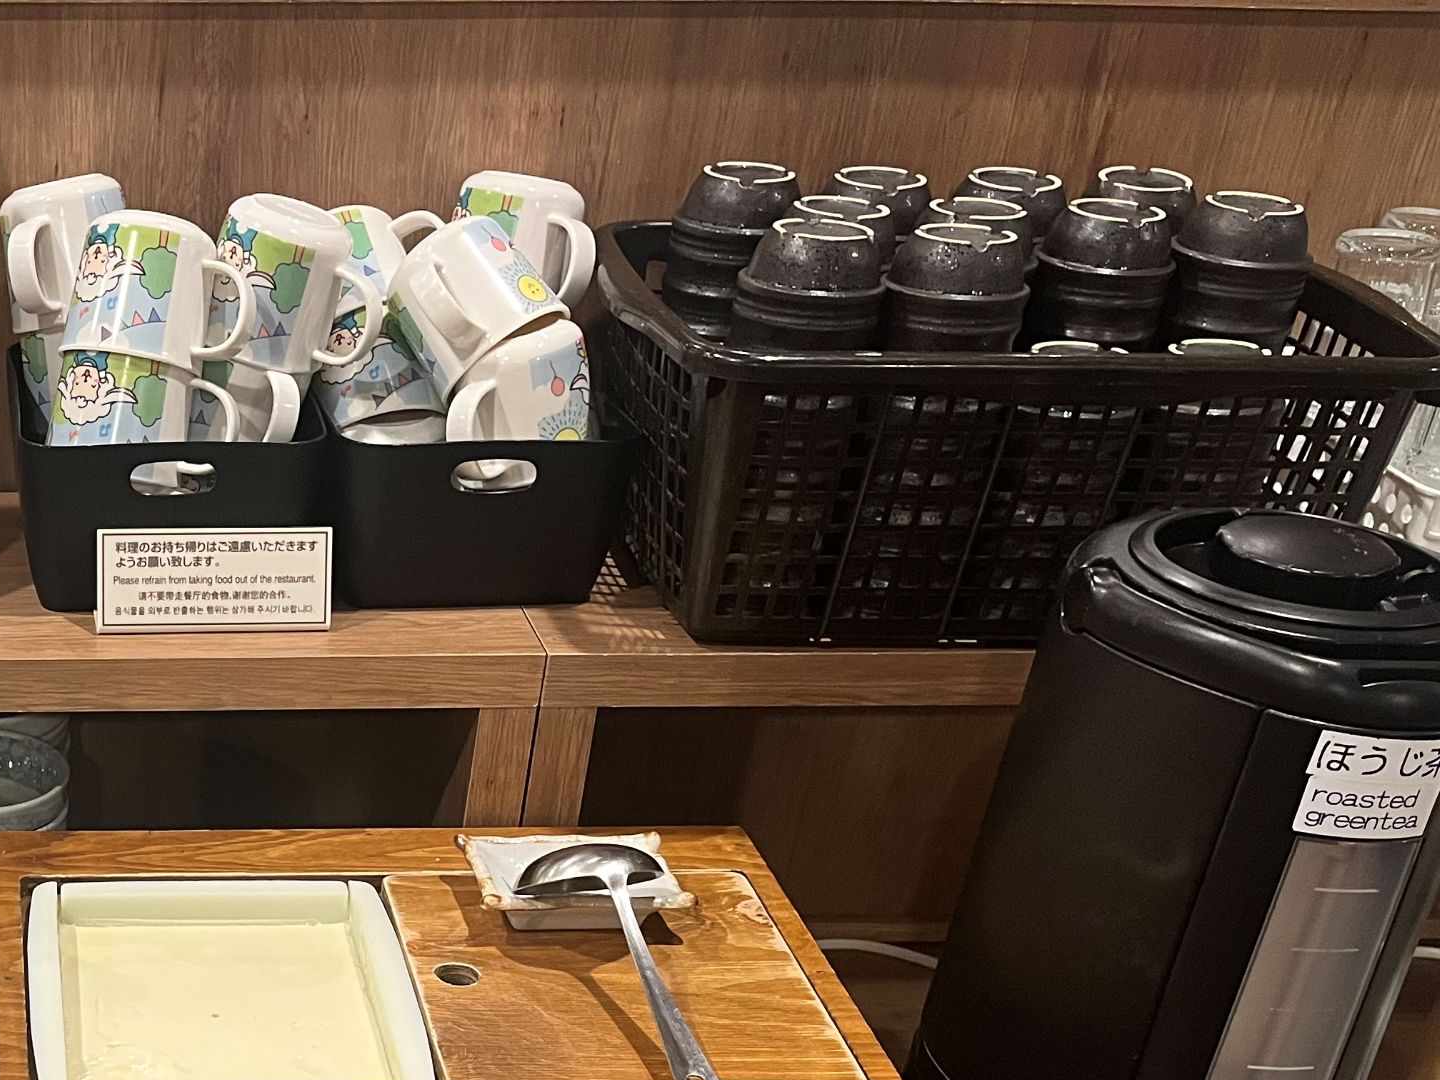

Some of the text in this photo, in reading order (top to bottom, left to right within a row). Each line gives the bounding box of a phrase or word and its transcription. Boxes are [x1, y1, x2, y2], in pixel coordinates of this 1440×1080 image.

[115, 541, 318, 554] 料理のお持ち帰りはご遠慮いただきます
[115, 556, 220, 568] ようお願い致します。
[113, 576, 139, 585] Please
[142, 575, 166, 585] refrain
[168, 575, 186, 585] from
[188, 575, 213, 587] taking
[215, 575, 233, 584] food
[234, 575, 248, 584] out
[250, 574, 258, 584] of
[259, 574, 272, 584] the
[1312, 789, 1421, 809] roasted
[1304, 810, 1419, 831] greentea
